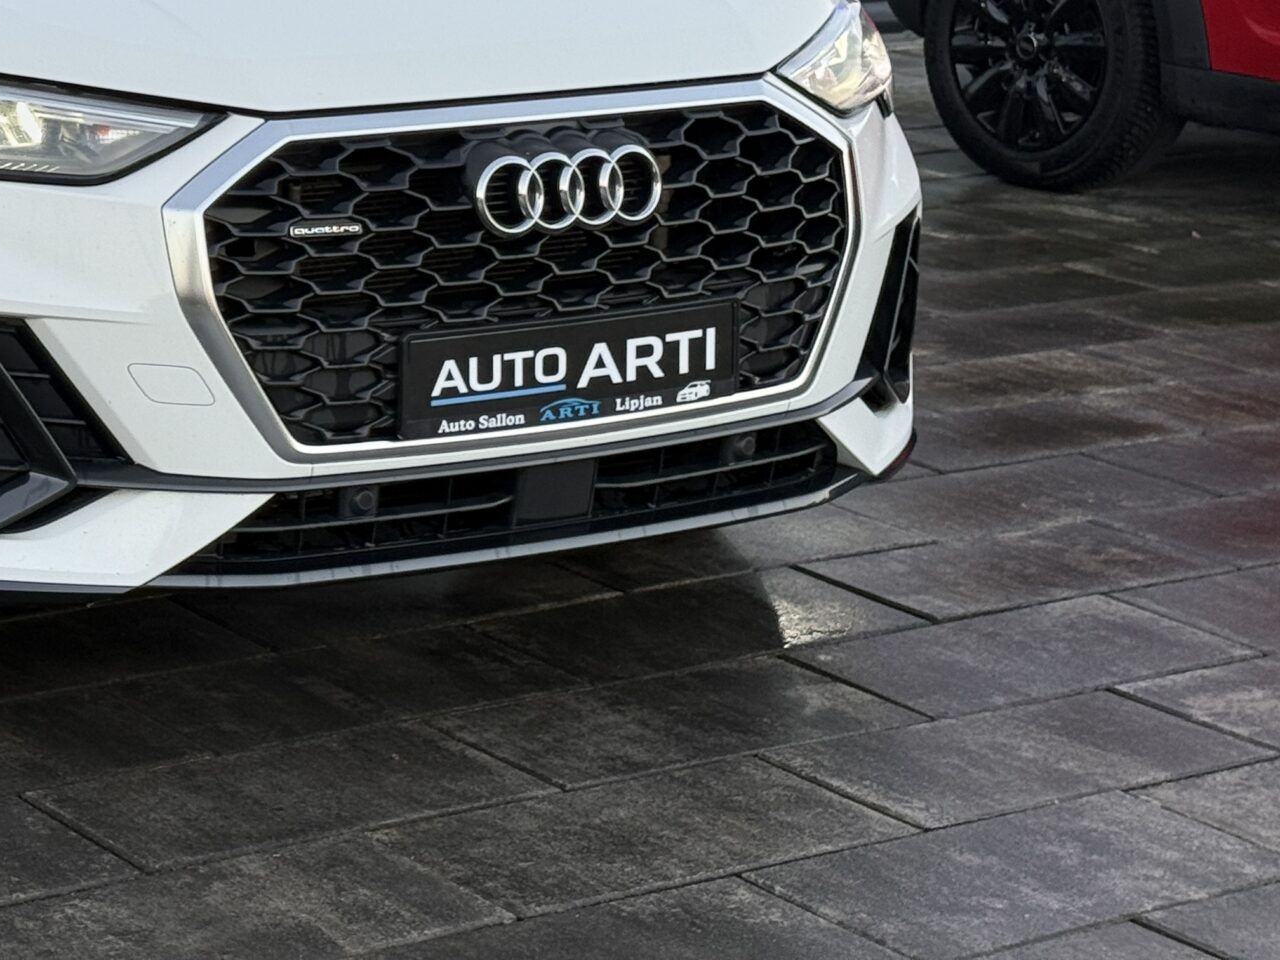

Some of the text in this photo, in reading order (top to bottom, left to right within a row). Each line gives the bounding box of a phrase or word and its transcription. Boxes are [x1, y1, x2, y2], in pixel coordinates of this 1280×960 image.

[294, 225, 359, 235] quattro
[431, 326, 717, 397] AUTO ARTI
[438, 393, 663, 434] Auto Sallon ARTI Lipjan
